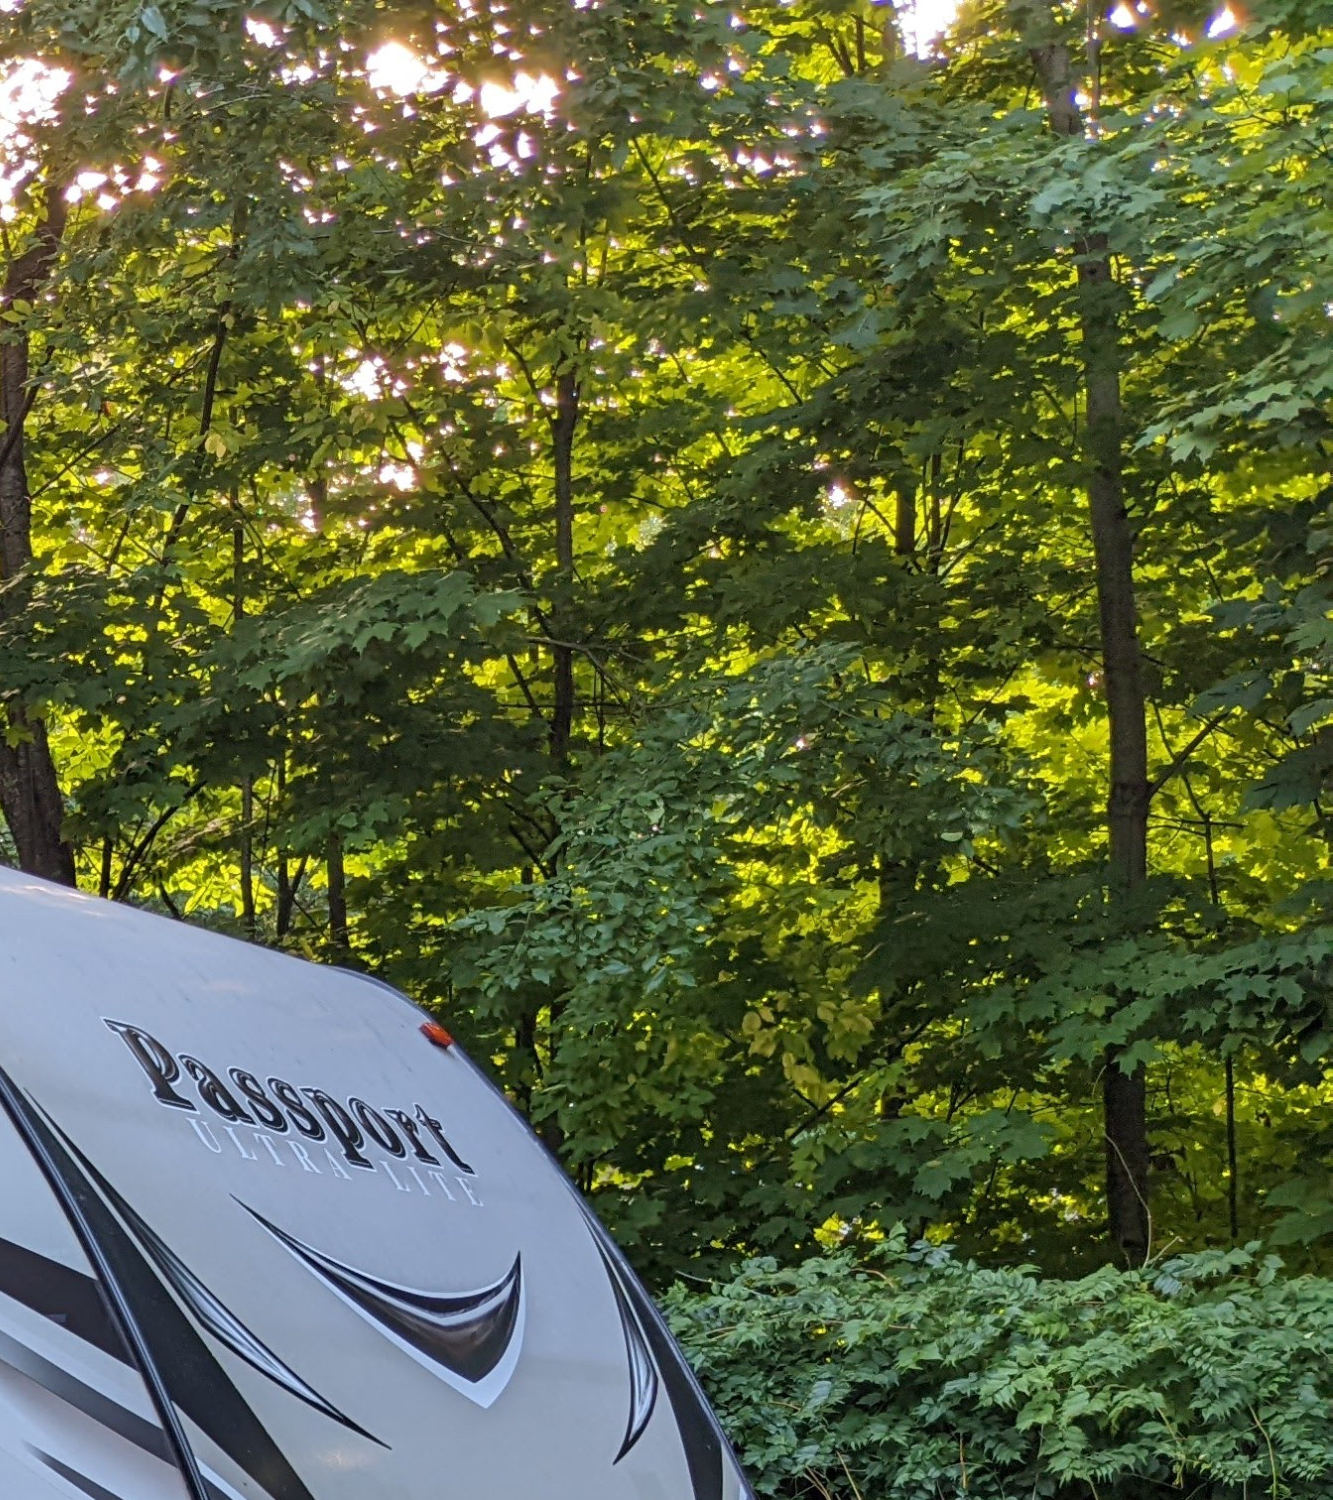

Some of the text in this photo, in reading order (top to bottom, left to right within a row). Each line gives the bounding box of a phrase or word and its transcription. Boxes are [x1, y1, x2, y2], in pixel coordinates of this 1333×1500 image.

[102, 1017, 476, 1176] Passport
[185, 1118, 484, 1207] ULTRA LITE
